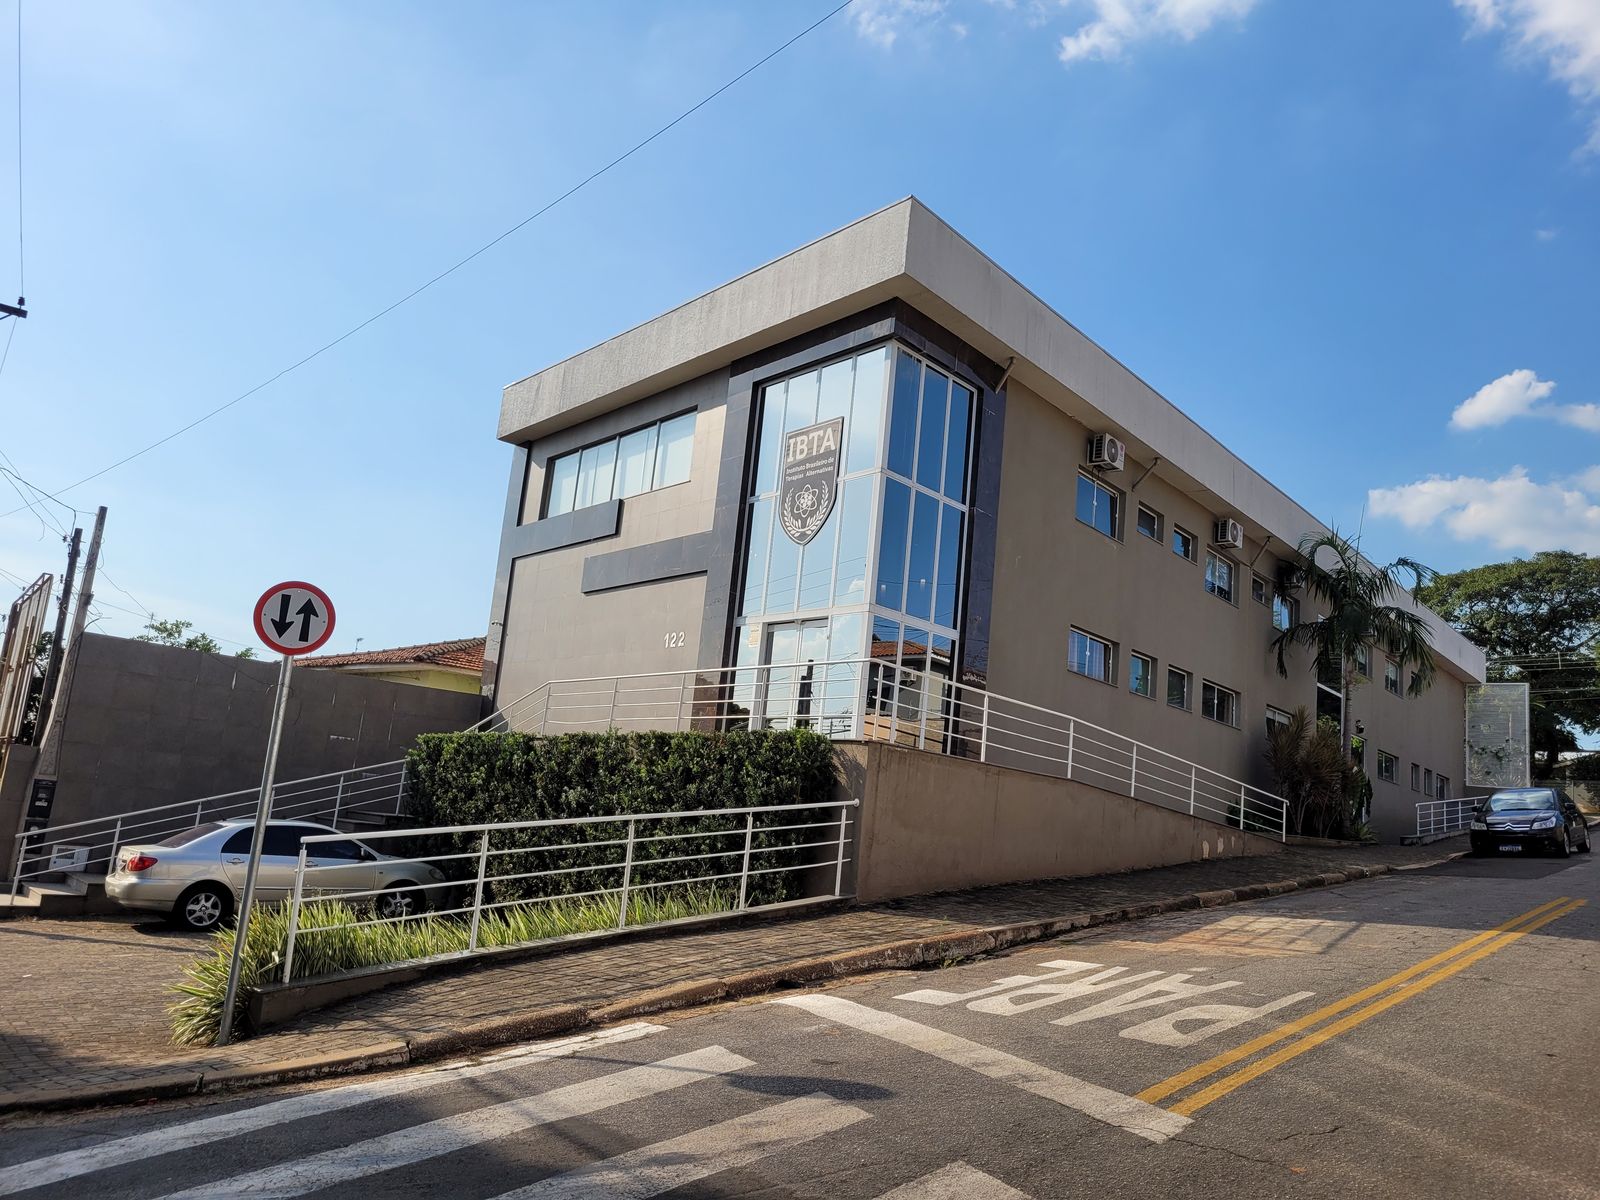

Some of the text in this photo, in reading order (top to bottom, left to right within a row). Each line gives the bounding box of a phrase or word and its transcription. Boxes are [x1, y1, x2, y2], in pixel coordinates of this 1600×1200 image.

[787, 427, 835, 462] IBTA
[664, 631, 685, 648] 122
[891, 958, 1317, 1048] PARE
